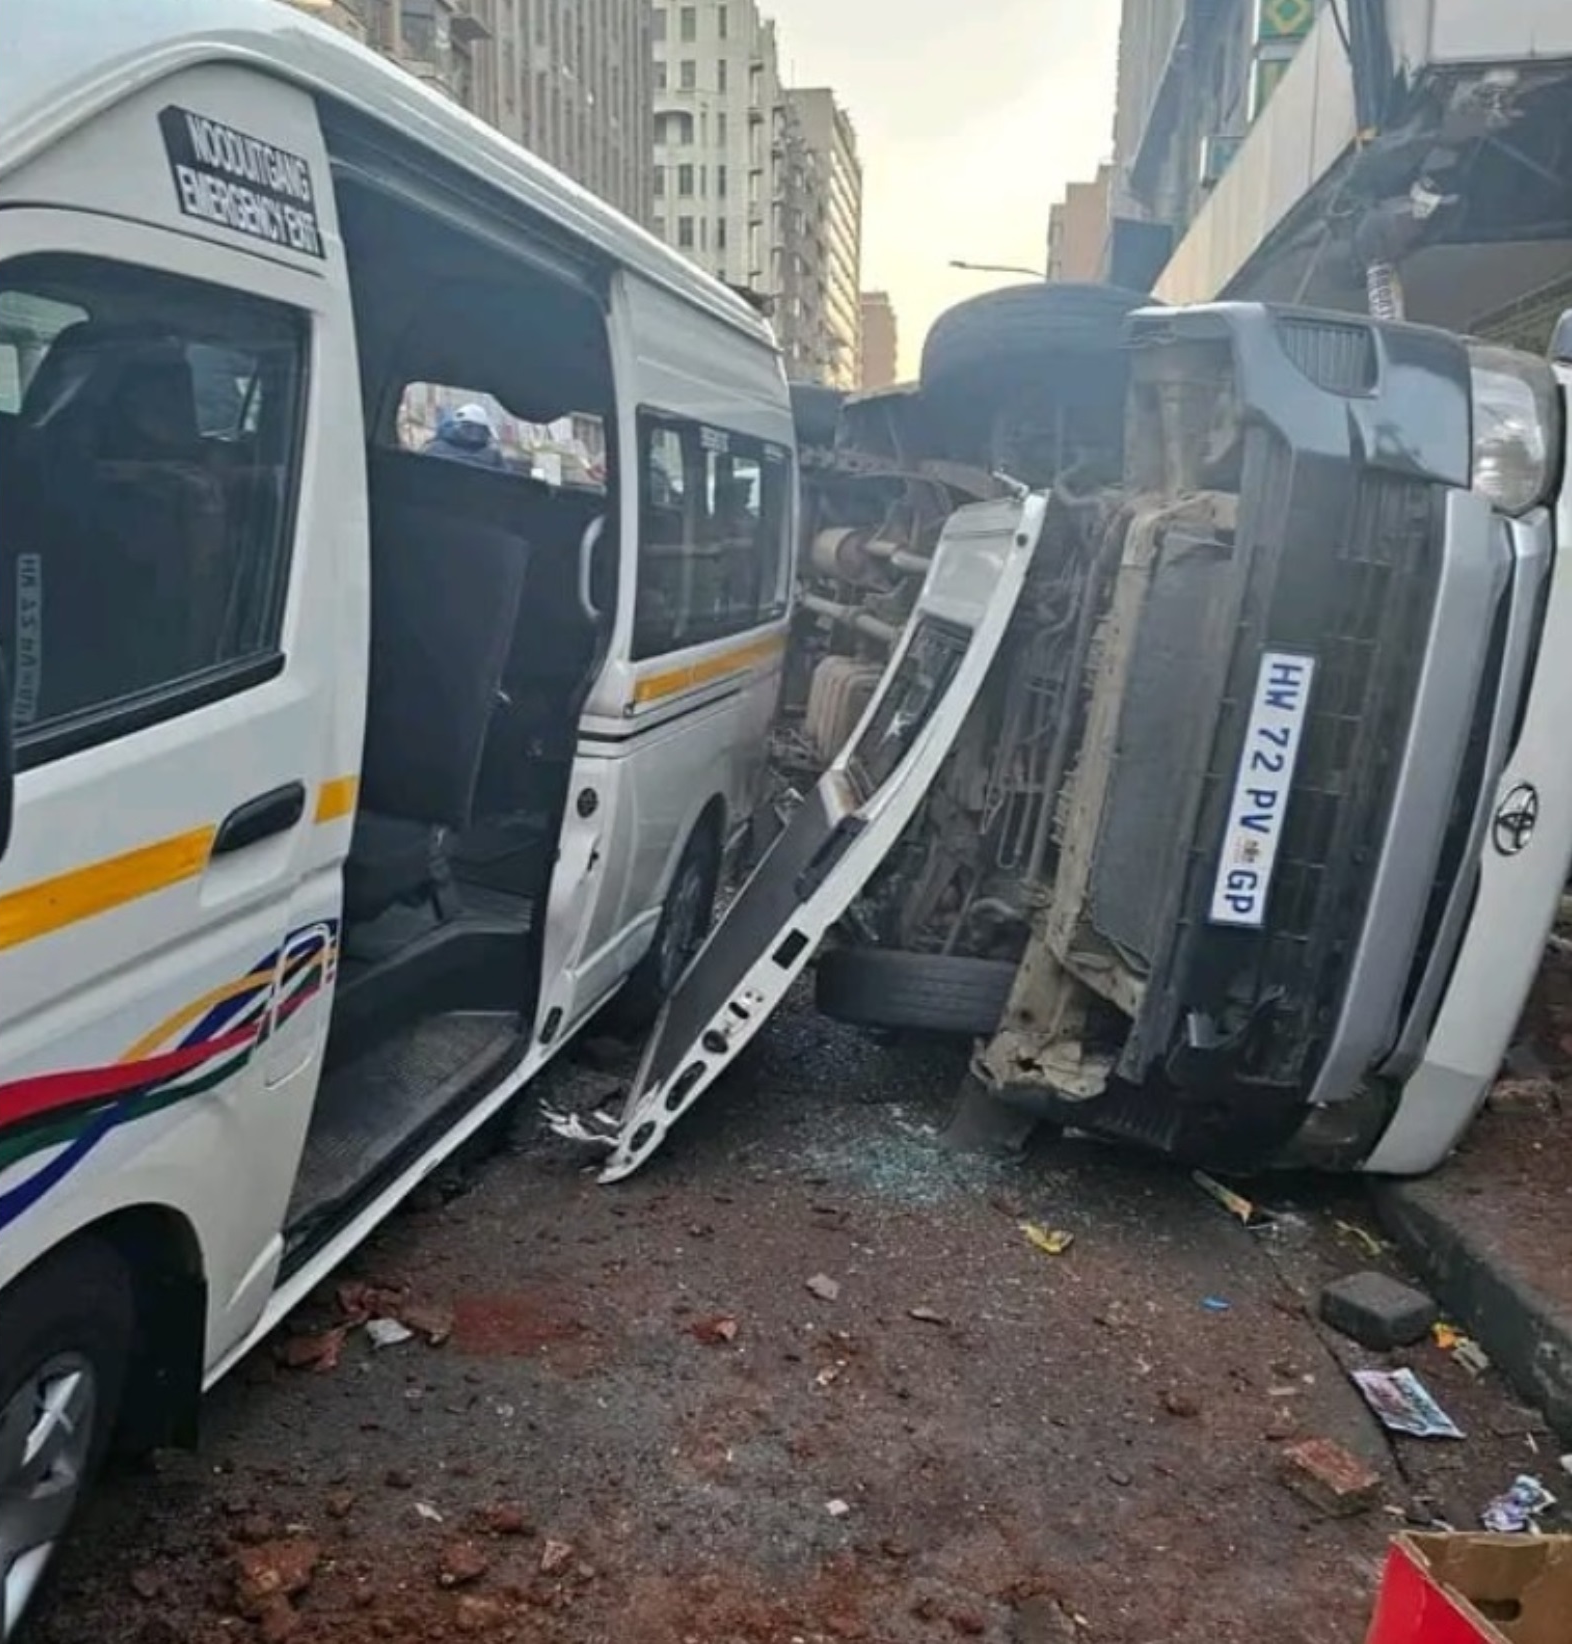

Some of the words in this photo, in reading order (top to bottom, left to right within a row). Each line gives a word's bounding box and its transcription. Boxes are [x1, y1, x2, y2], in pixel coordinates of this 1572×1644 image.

[185, 114, 310, 202] NOODUITGANG
[176, 164, 288, 242] EMERGENCY
[284, 204, 319, 255] EXIT
[1264, 663, 1304, 711] HW
[1251, 727, 1291, 773] 72
[1239, 788, 1278, 834] PV
[1224, 869, 1259, 914] GP
